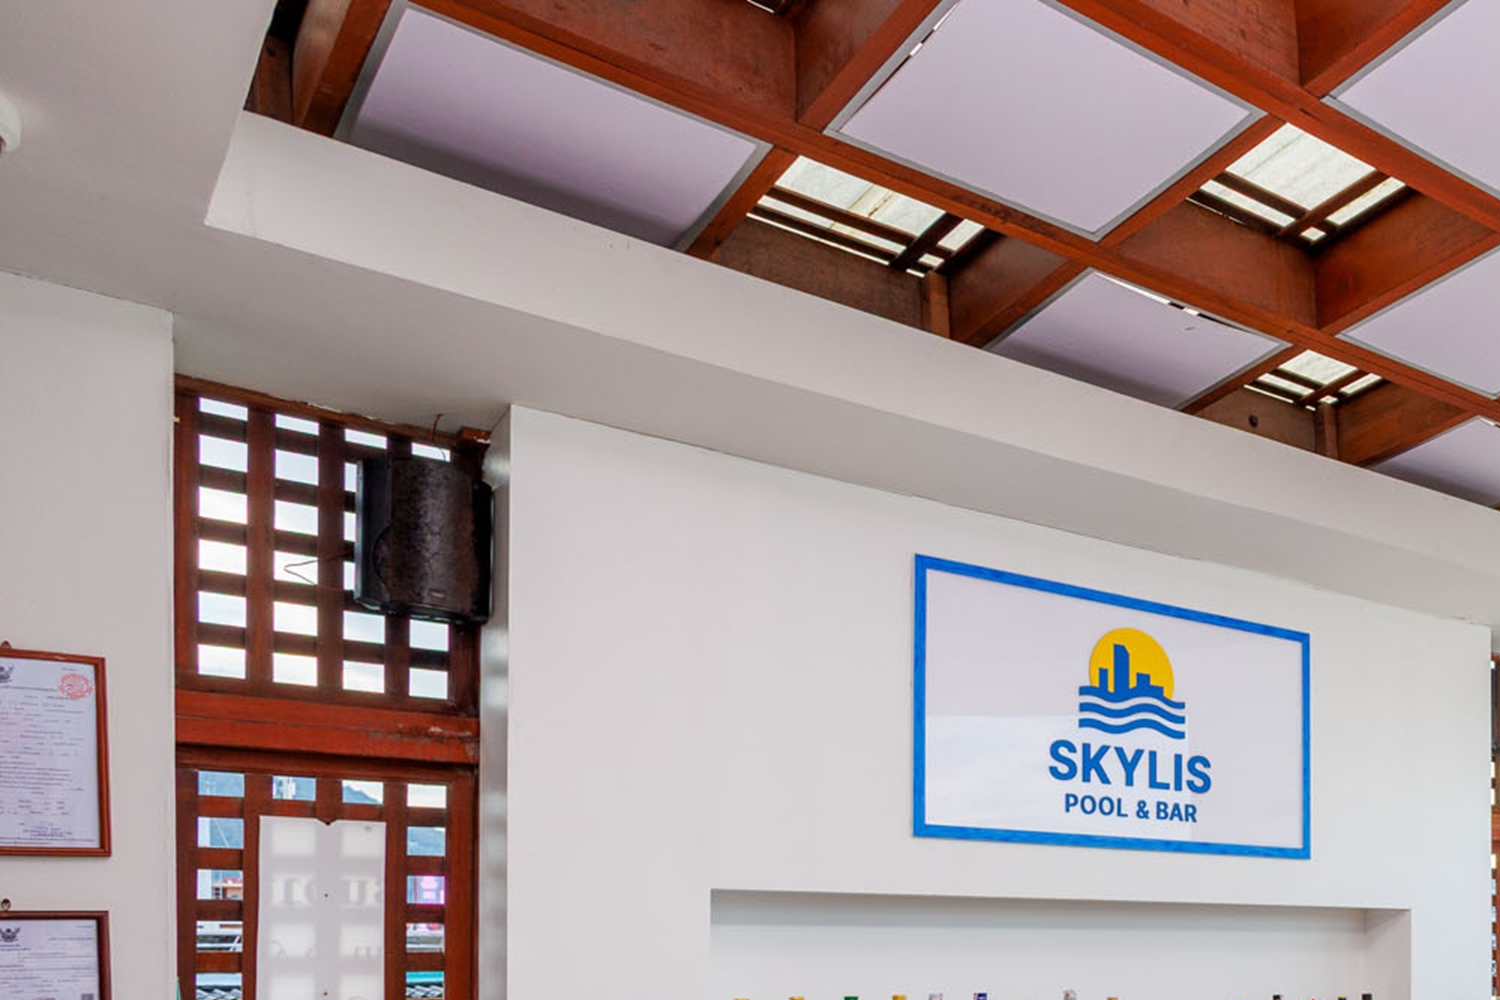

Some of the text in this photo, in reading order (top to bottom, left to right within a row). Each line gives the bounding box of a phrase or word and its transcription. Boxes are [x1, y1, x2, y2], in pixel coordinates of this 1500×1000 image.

[1049, 740, 1212, 795] SKYLIS
[1065, 793, 1198, 823] POOL & BAR
